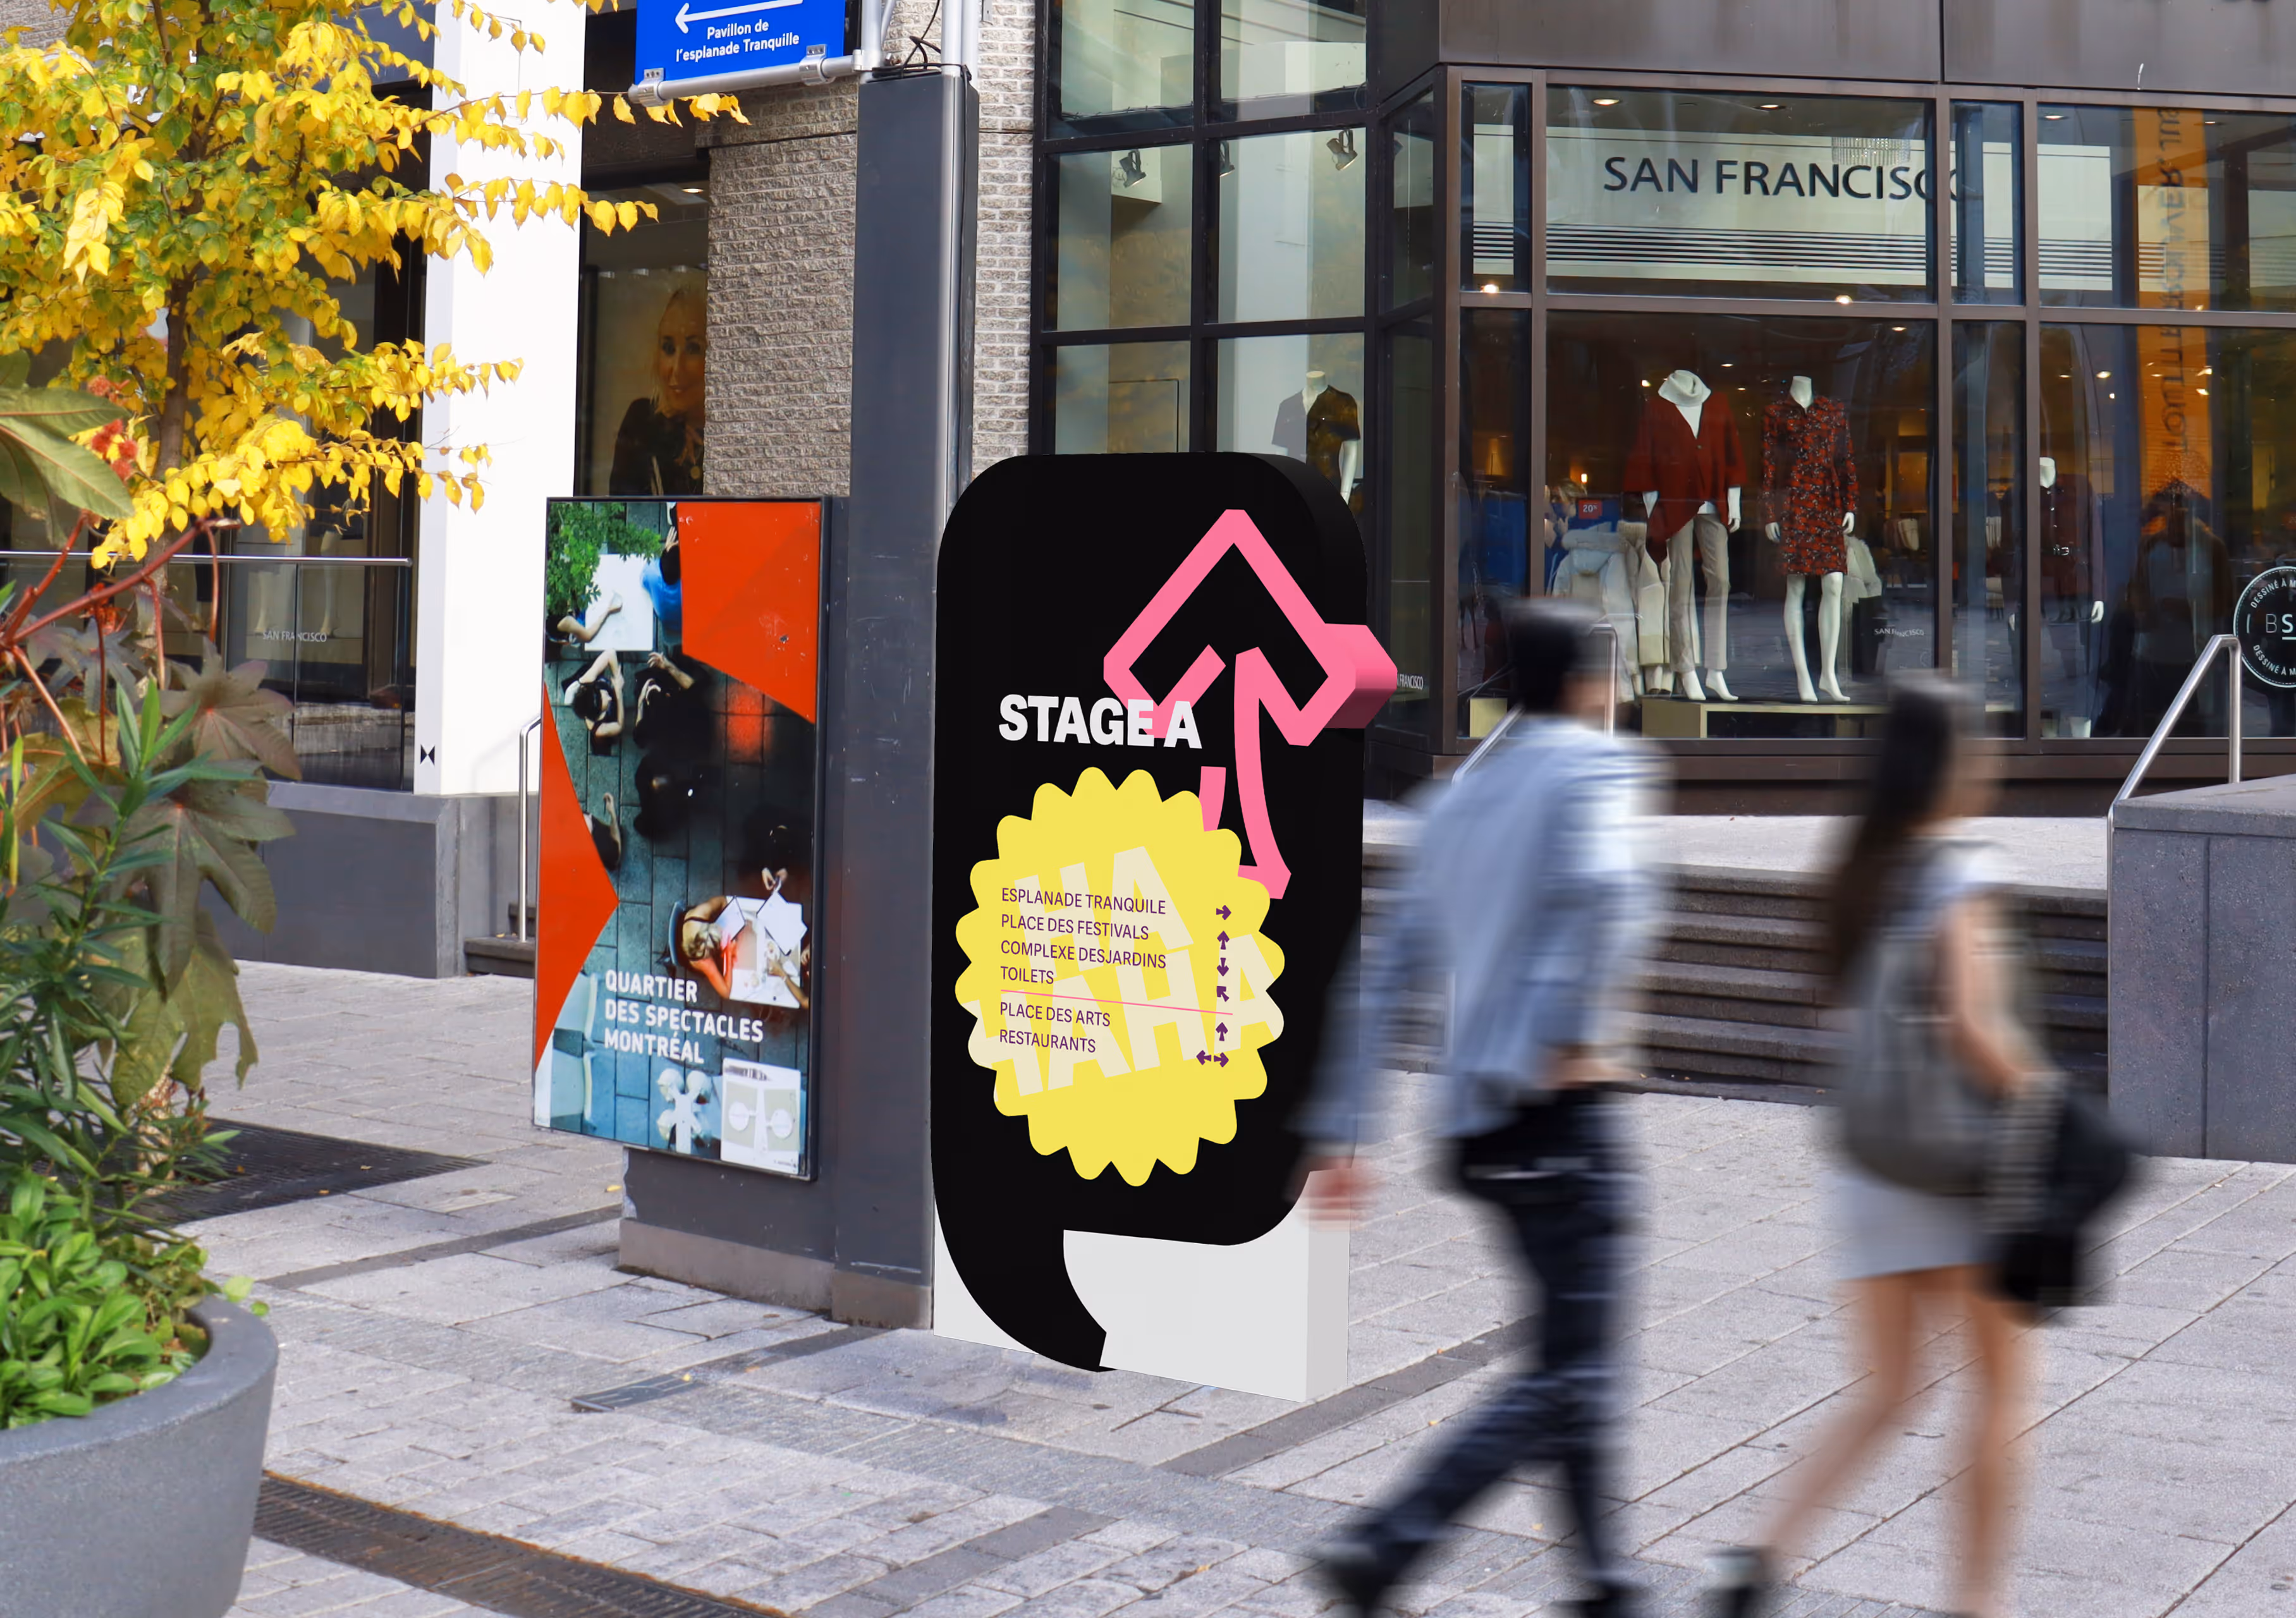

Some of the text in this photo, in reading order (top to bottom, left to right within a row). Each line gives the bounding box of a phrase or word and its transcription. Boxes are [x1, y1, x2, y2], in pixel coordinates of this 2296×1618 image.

[707, 18, 769, 40] Pavillon de
[676, 32, 800, 62] l'esplanade Tranquille
[1603, 156, 1958, 202] SAN FRANCISC
[2250, 580, 2279, 609] DESSINÉ
[262, 630, 327, 643] SAN FRANCISCO
[2252, 644, 2280, 674] DESSINÉ
[999, 694, 1202, 749] STAGE A
[1002, 887, 1166, 915] ESPLANADE TRANQUILE
[1001, 914, 1149, 940] PLACE DES FESTIVALS
[1001, 940, 1166, 969] COMPLEXE DESJARDINS
[605, 970, 698, 1002] QUARTIER
[1000, 966, 1054, 985] TOILETS
[604, 999, 764, 1043] DES SPECTACLES
[1000, 1002, 1110, 1027] PLACE DES ARTS
[604, 1028, 705, 1064] MONTRÉAL
[1000, 1029, 1096, 1053] RESTAURANTS
